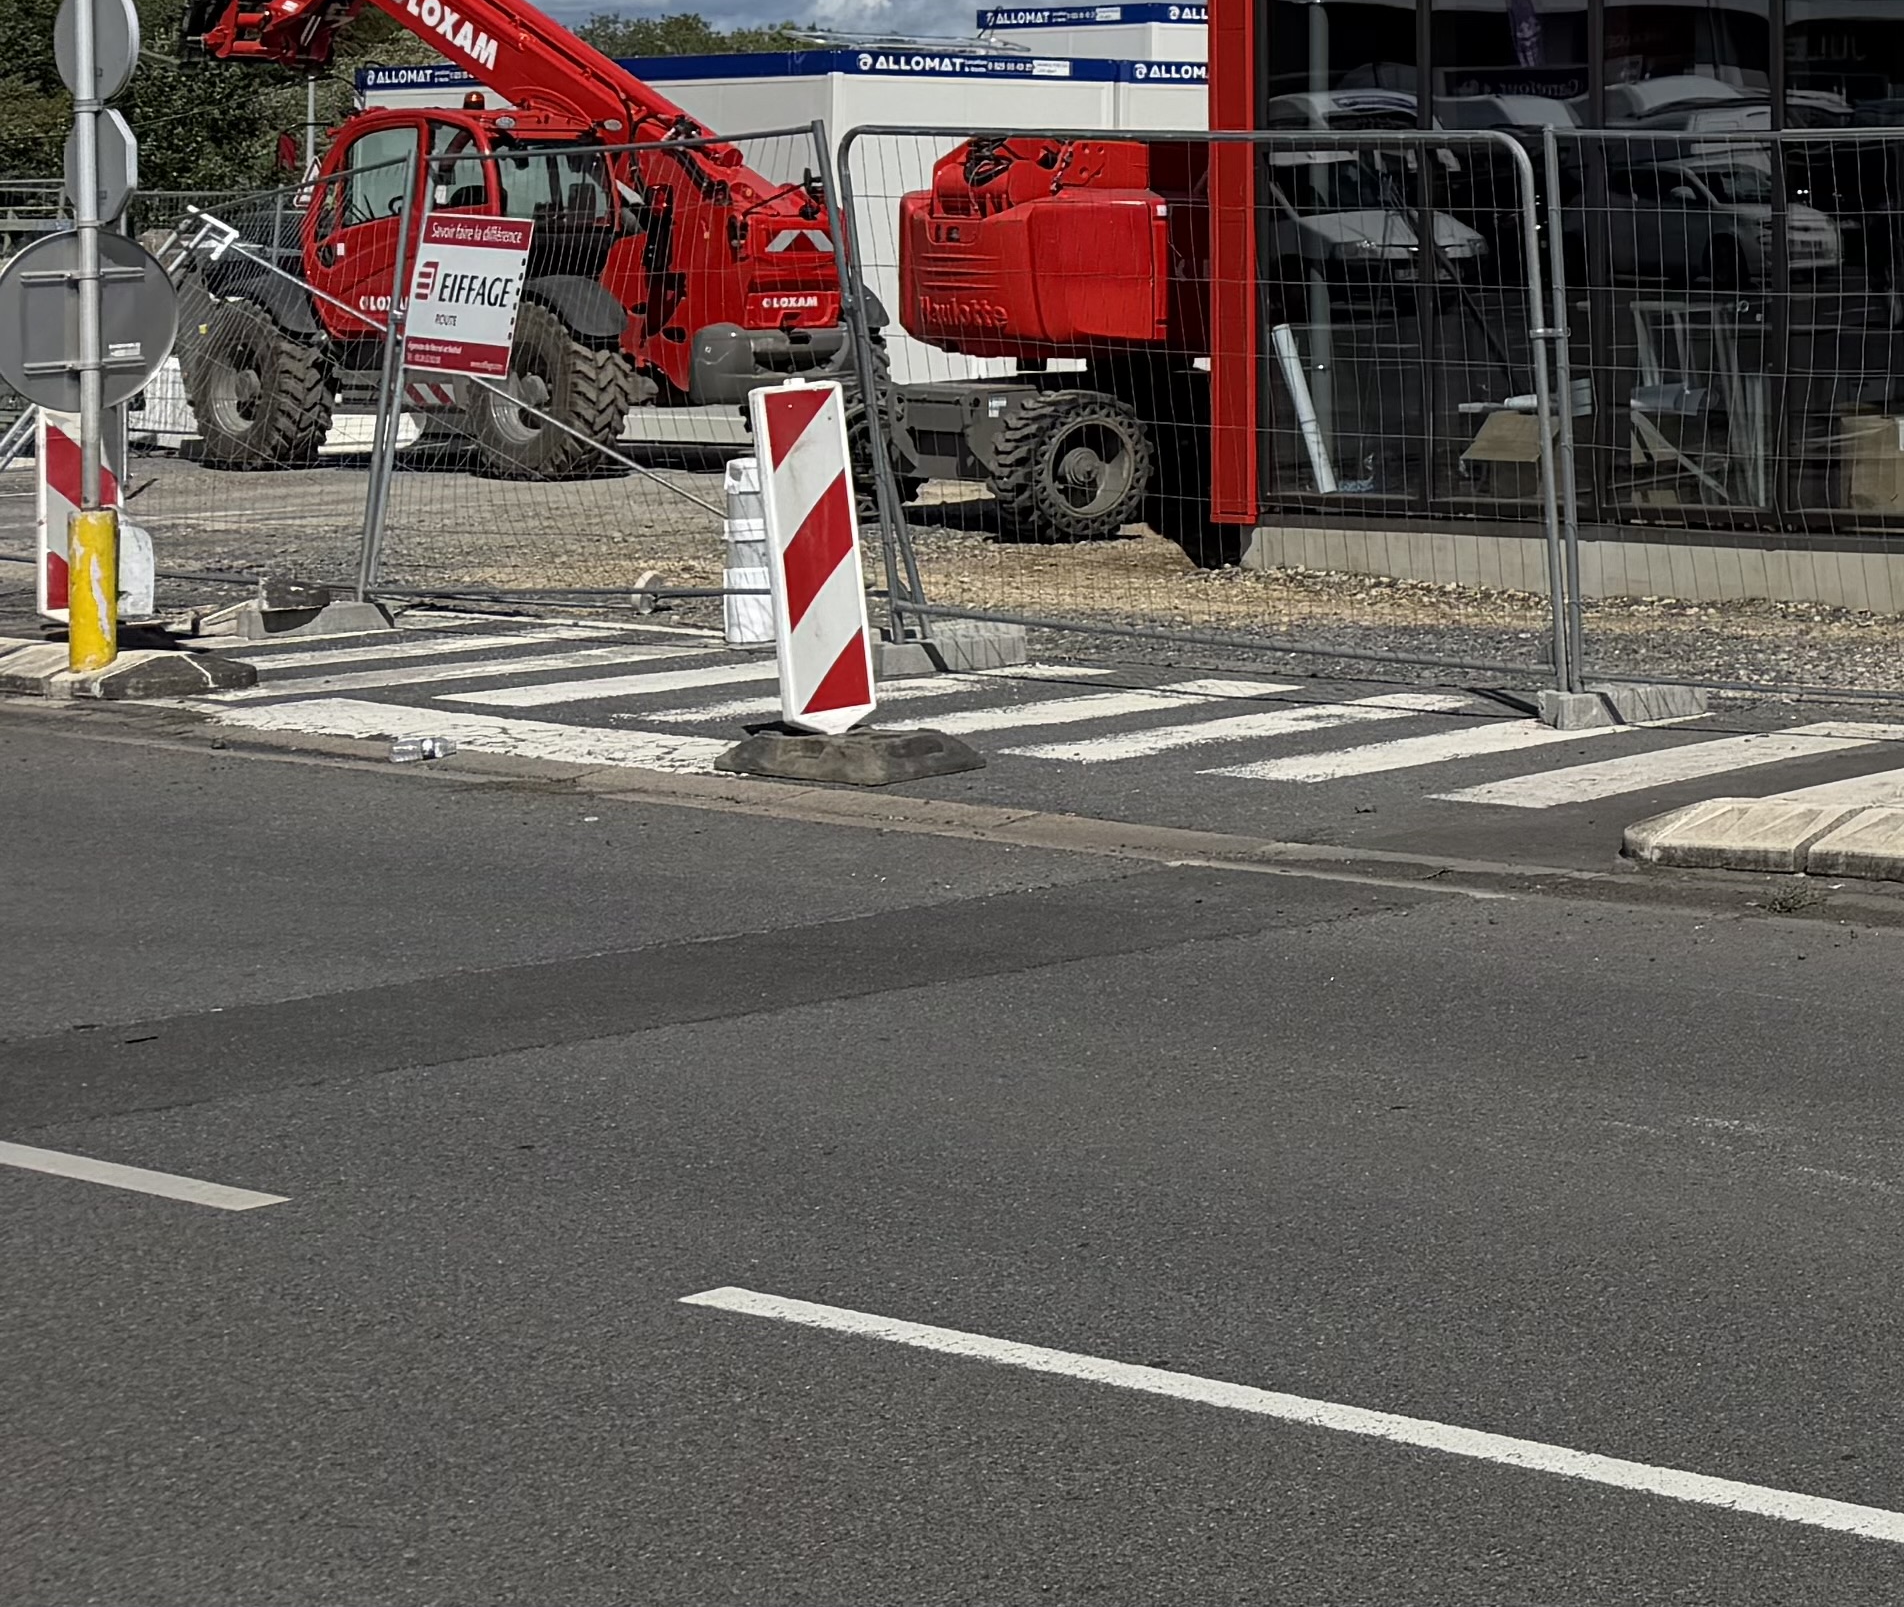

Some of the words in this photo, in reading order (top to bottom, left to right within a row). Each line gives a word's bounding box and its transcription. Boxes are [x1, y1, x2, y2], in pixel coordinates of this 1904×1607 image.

[996, 12, 1050, 25] ALLOMAT
[875, 55, 964, 72] ALLOMAT
[376, 70, 433, 84] ALLOMAT
[1149, 65, 1208, 79] ALLOM
[438, 272, 514, 308] EIFFAGE
[772, 296, 818, 308] LOXAM
